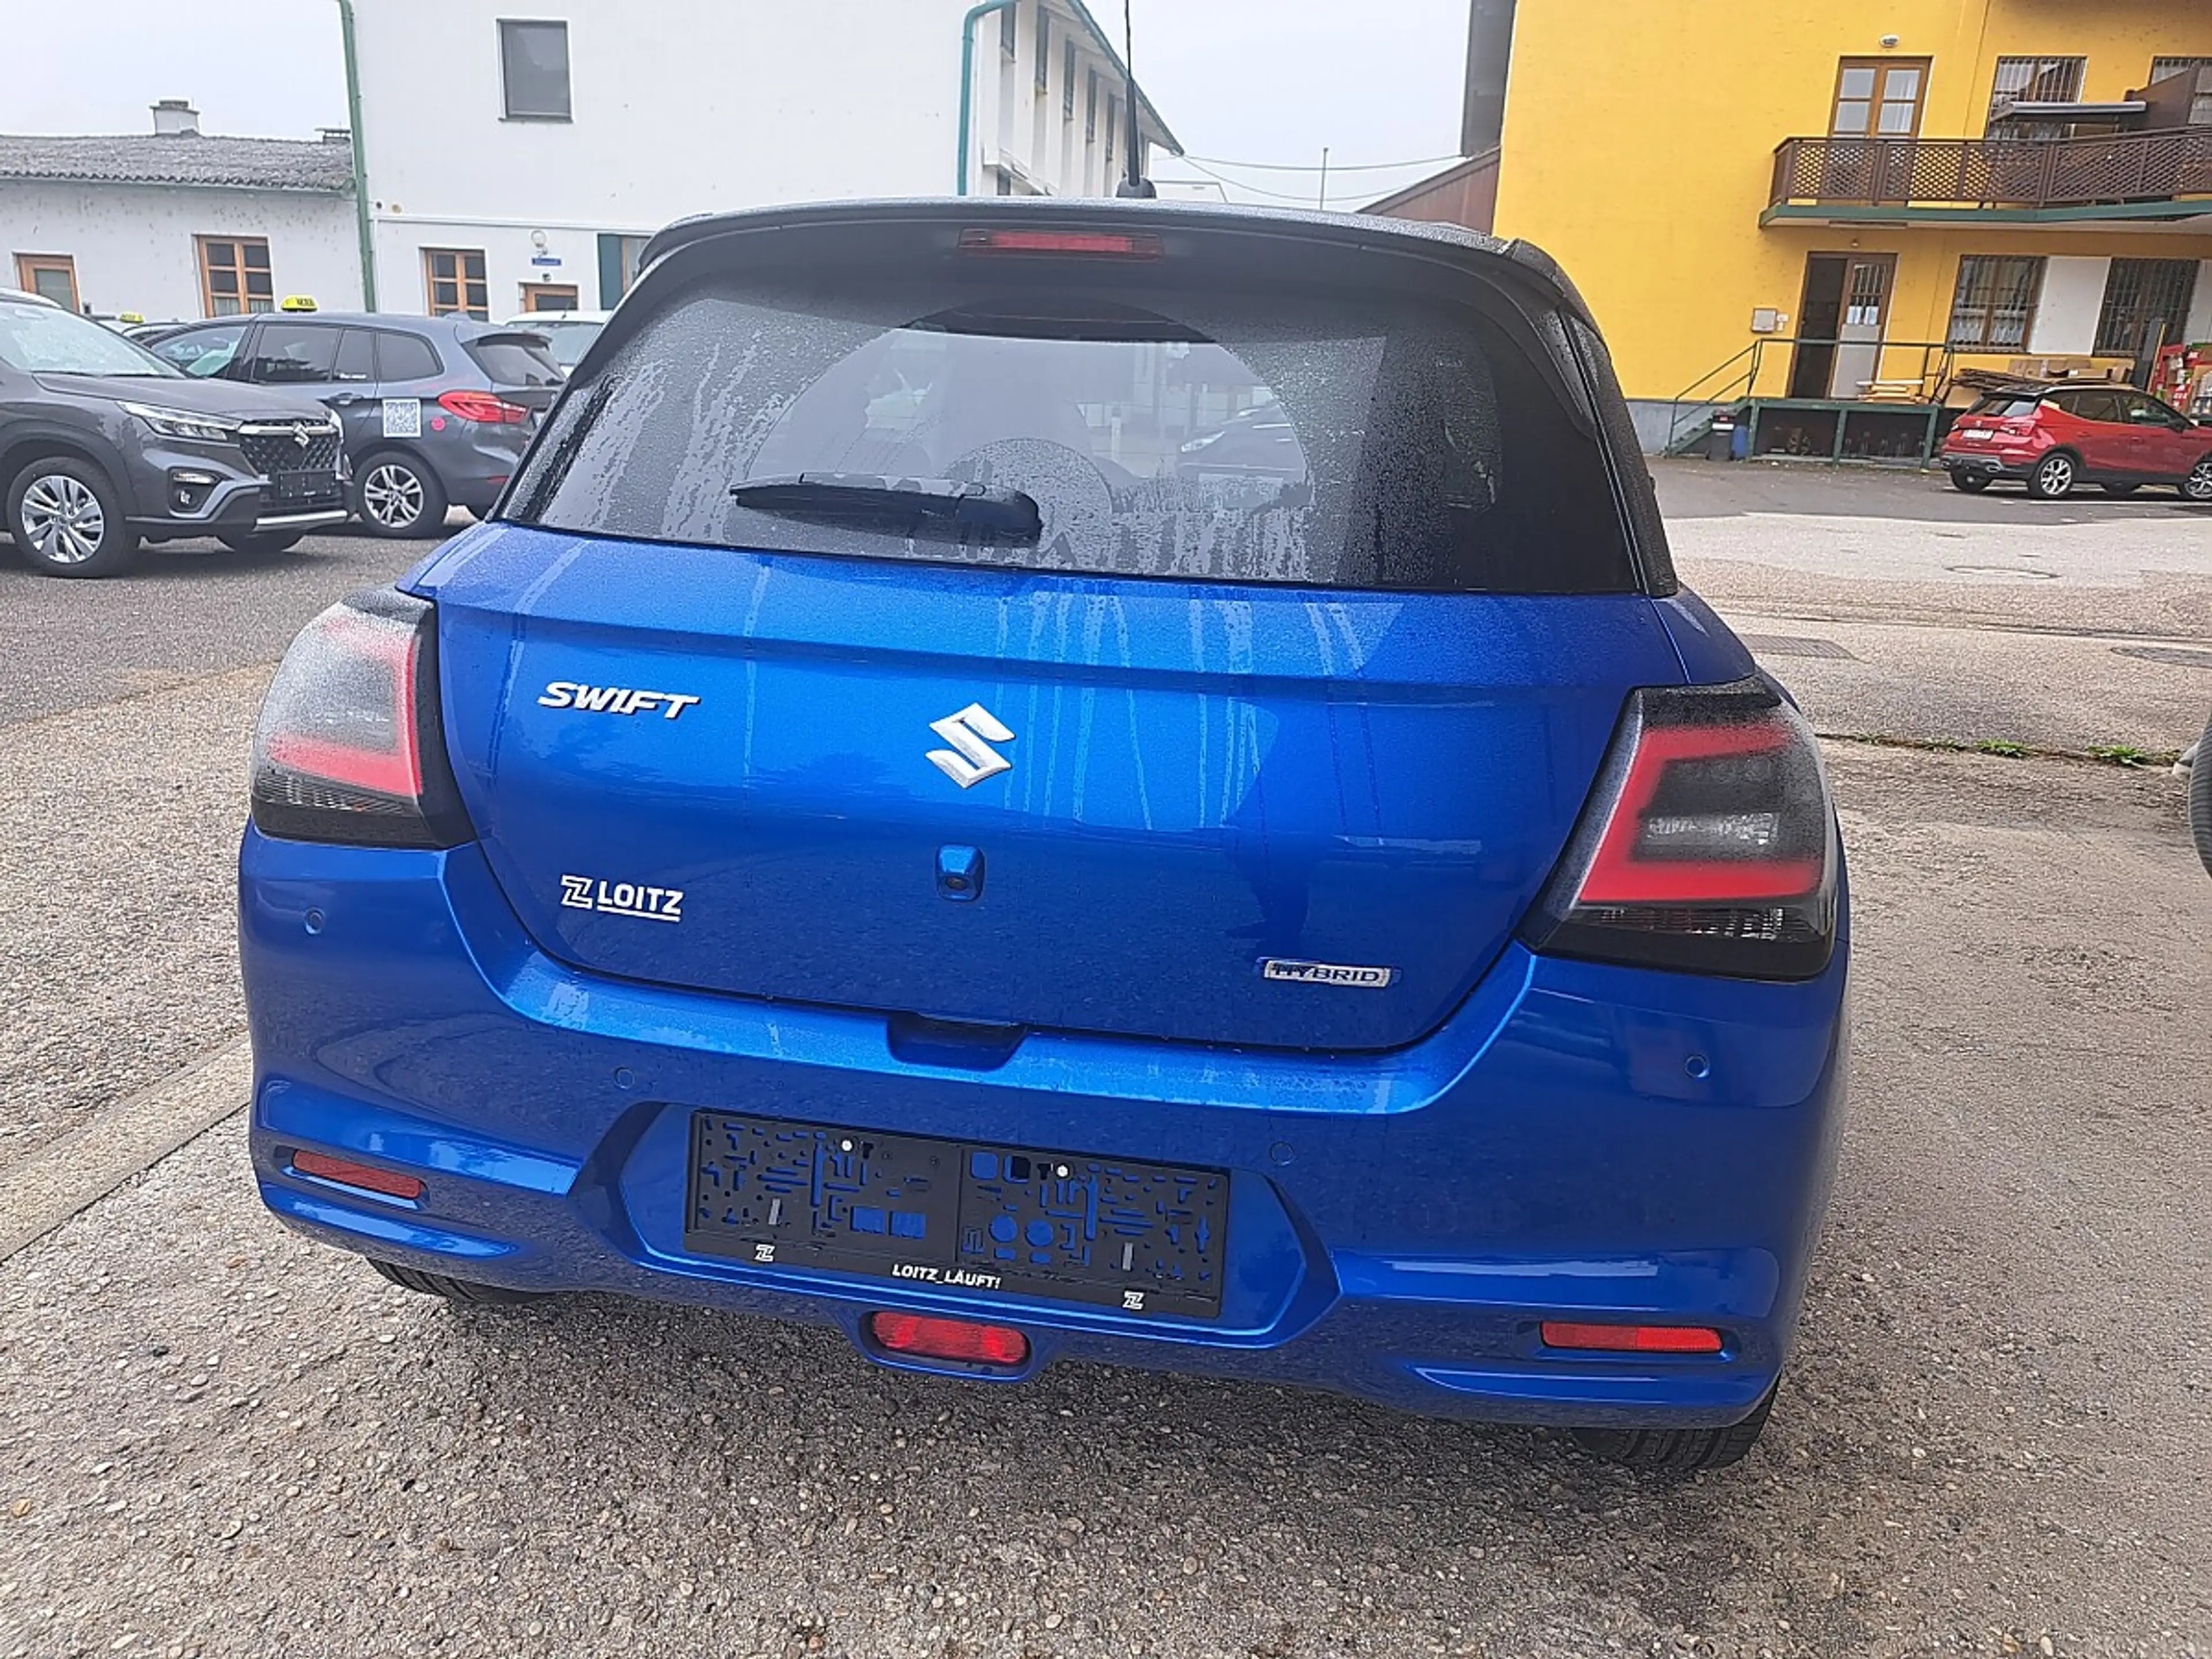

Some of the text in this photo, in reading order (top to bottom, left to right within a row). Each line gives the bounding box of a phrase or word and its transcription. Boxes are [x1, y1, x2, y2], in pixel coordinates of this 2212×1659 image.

[537, 682, 700, 718] SWIFT
[597, 881, 684, 916] LOITZ
[1271, 963, 1380, 983] HYBRID
